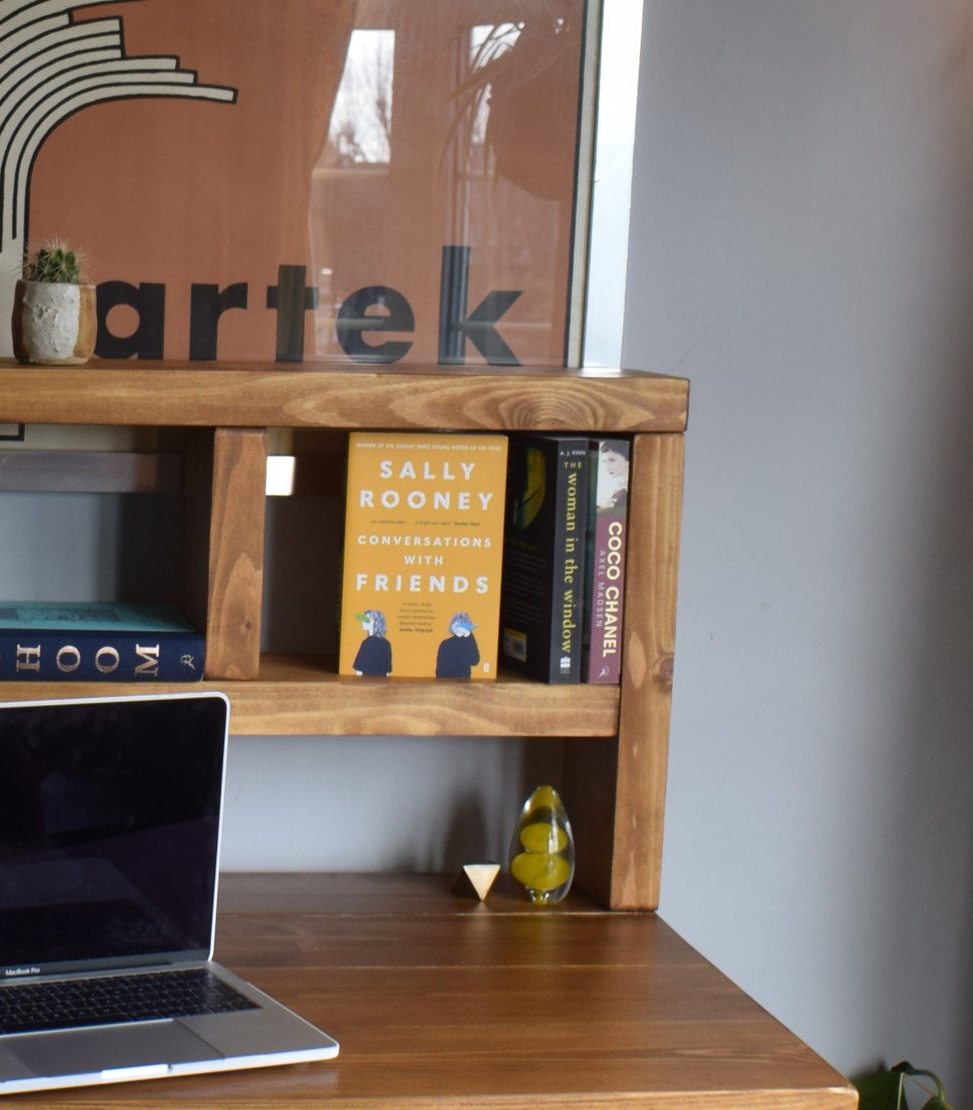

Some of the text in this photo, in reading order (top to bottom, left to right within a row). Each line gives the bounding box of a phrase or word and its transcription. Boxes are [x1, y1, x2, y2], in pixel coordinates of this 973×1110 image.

[95, 245, 524, 366] artek
[379, 460, 475, 480] SALLY
[564, 461, 582, 469] THE
[359, 489, 493, 510] ROONEY
[566, 472, 578, 531] woman
[357, 534, 492, 548] CONVERSATIONS
[565, 538, 579, 553] in
[404, 555, 443, 566] WITH
[564, 558, 579, 584] the
[355, 573, 490, 594] FRIENDS
[595, 549, 607, 628] AXEL MADSEN
[602, 521, 623, 658] COCO CHANEL
[562, 589, 577, 653] window
